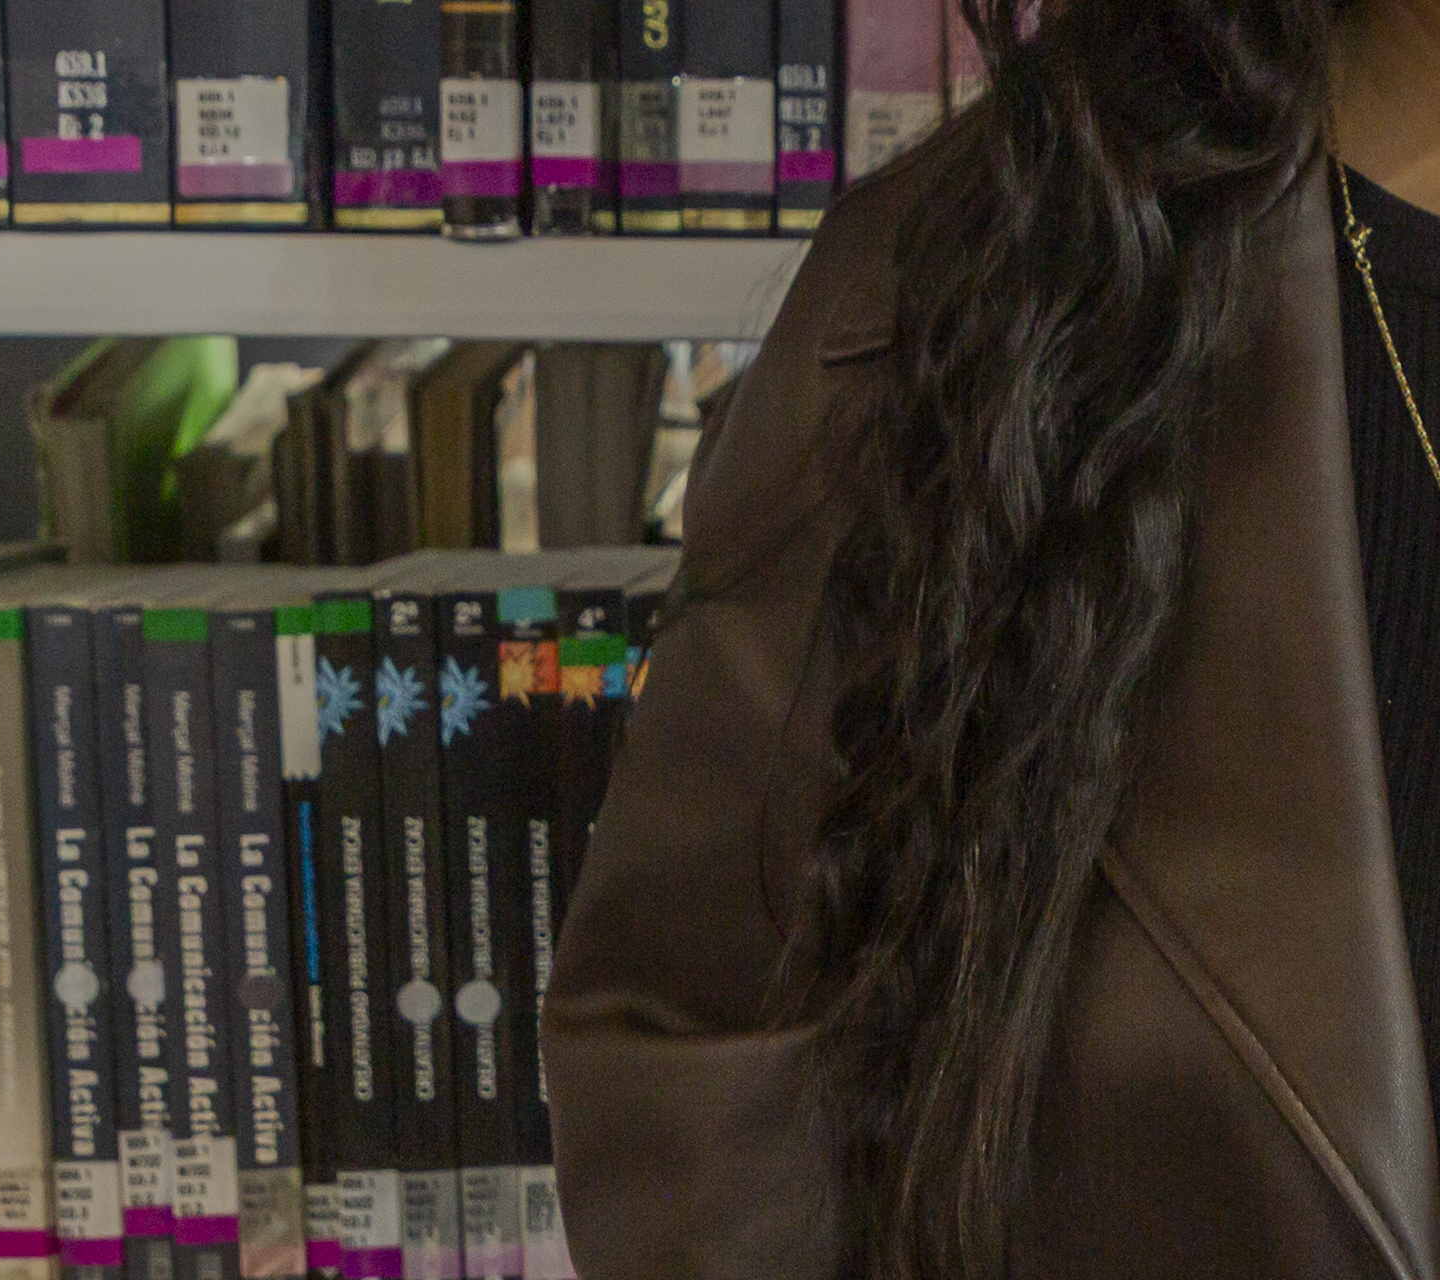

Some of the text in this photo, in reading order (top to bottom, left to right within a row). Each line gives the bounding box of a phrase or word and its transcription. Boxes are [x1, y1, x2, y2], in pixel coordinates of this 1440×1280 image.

[56, 828, 87, 862] La
[125, 826, 156, 860] La
[175, 833, 205, 867] La
[239, 833, 271, 867] La
